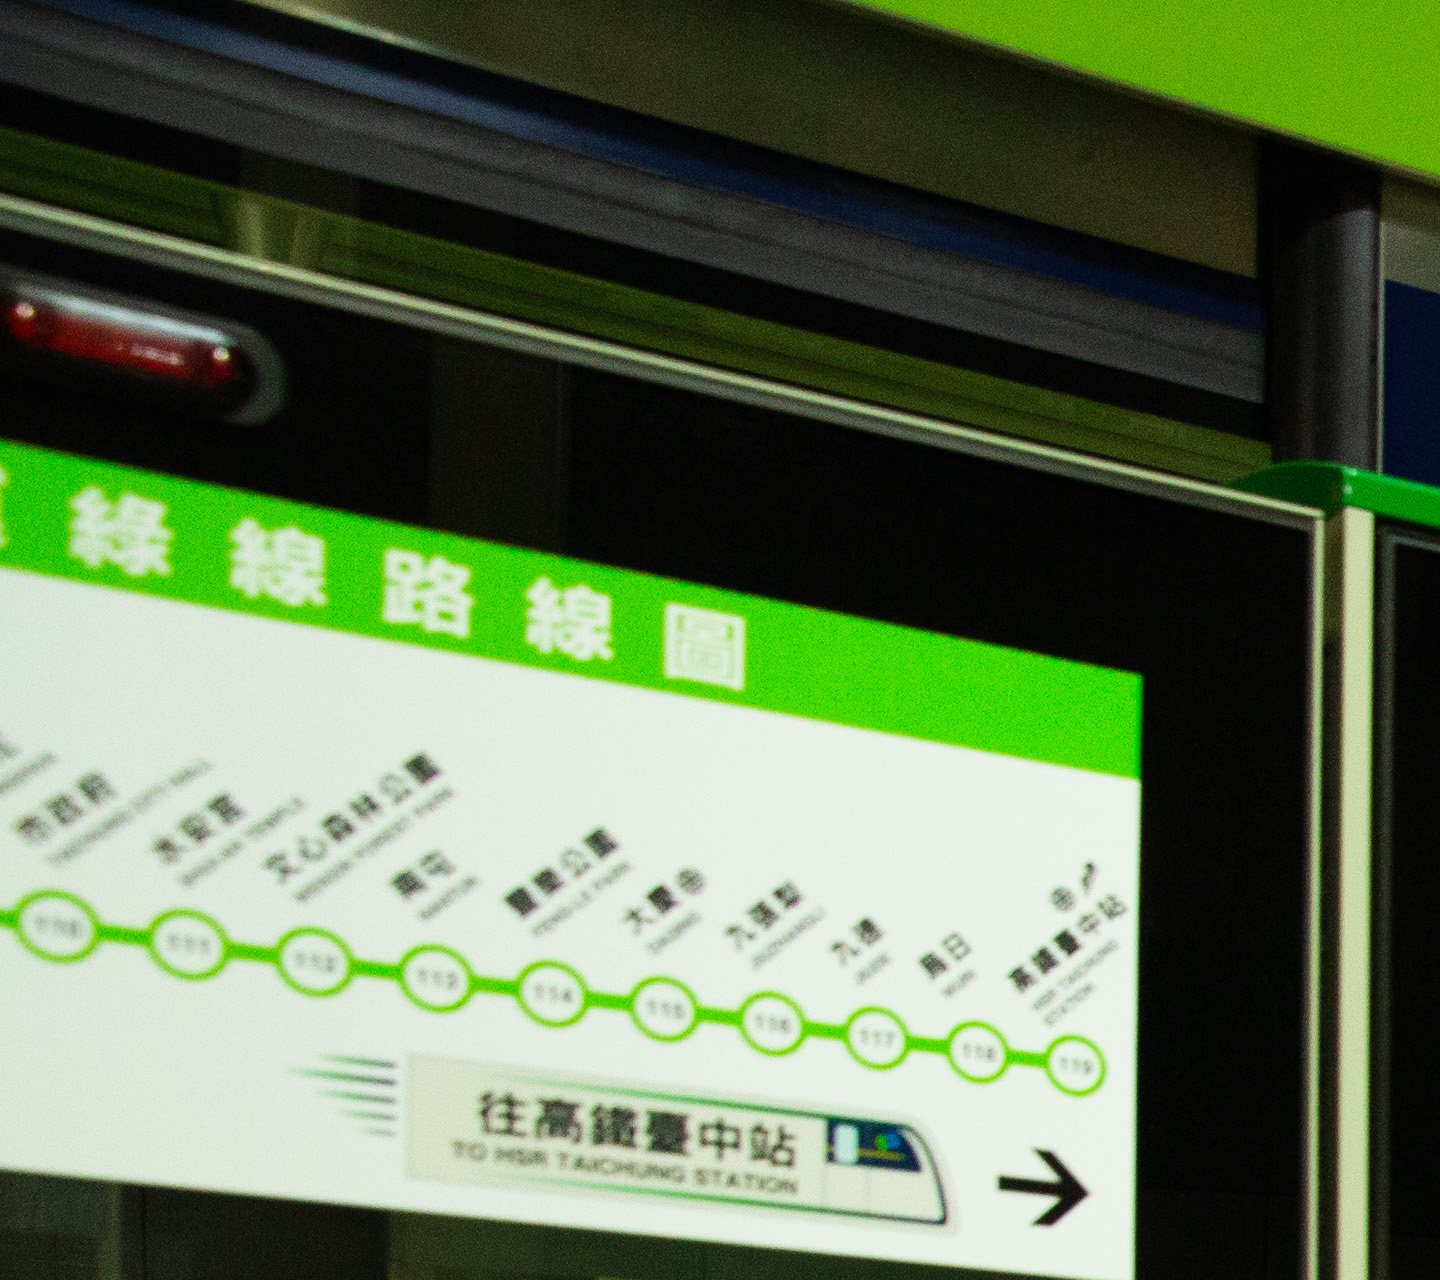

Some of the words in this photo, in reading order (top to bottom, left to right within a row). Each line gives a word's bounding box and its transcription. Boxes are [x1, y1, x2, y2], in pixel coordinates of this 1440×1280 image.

[0, 466, 746, 691] 綠線路線圖
[262, 750, 441, 884] 文心森林公園
[1008, 894, 1128, 993] 高鐵臺中站
[451, 1139, 487, 1162] TO
[494, 1147, 549, 1169] HSR
[558, 1151, 686, 1185] TAICHUNG
[693, 1167, 798, 1196] STATION
[478, 1090, 798, 1168] 往高鐵臺中站
